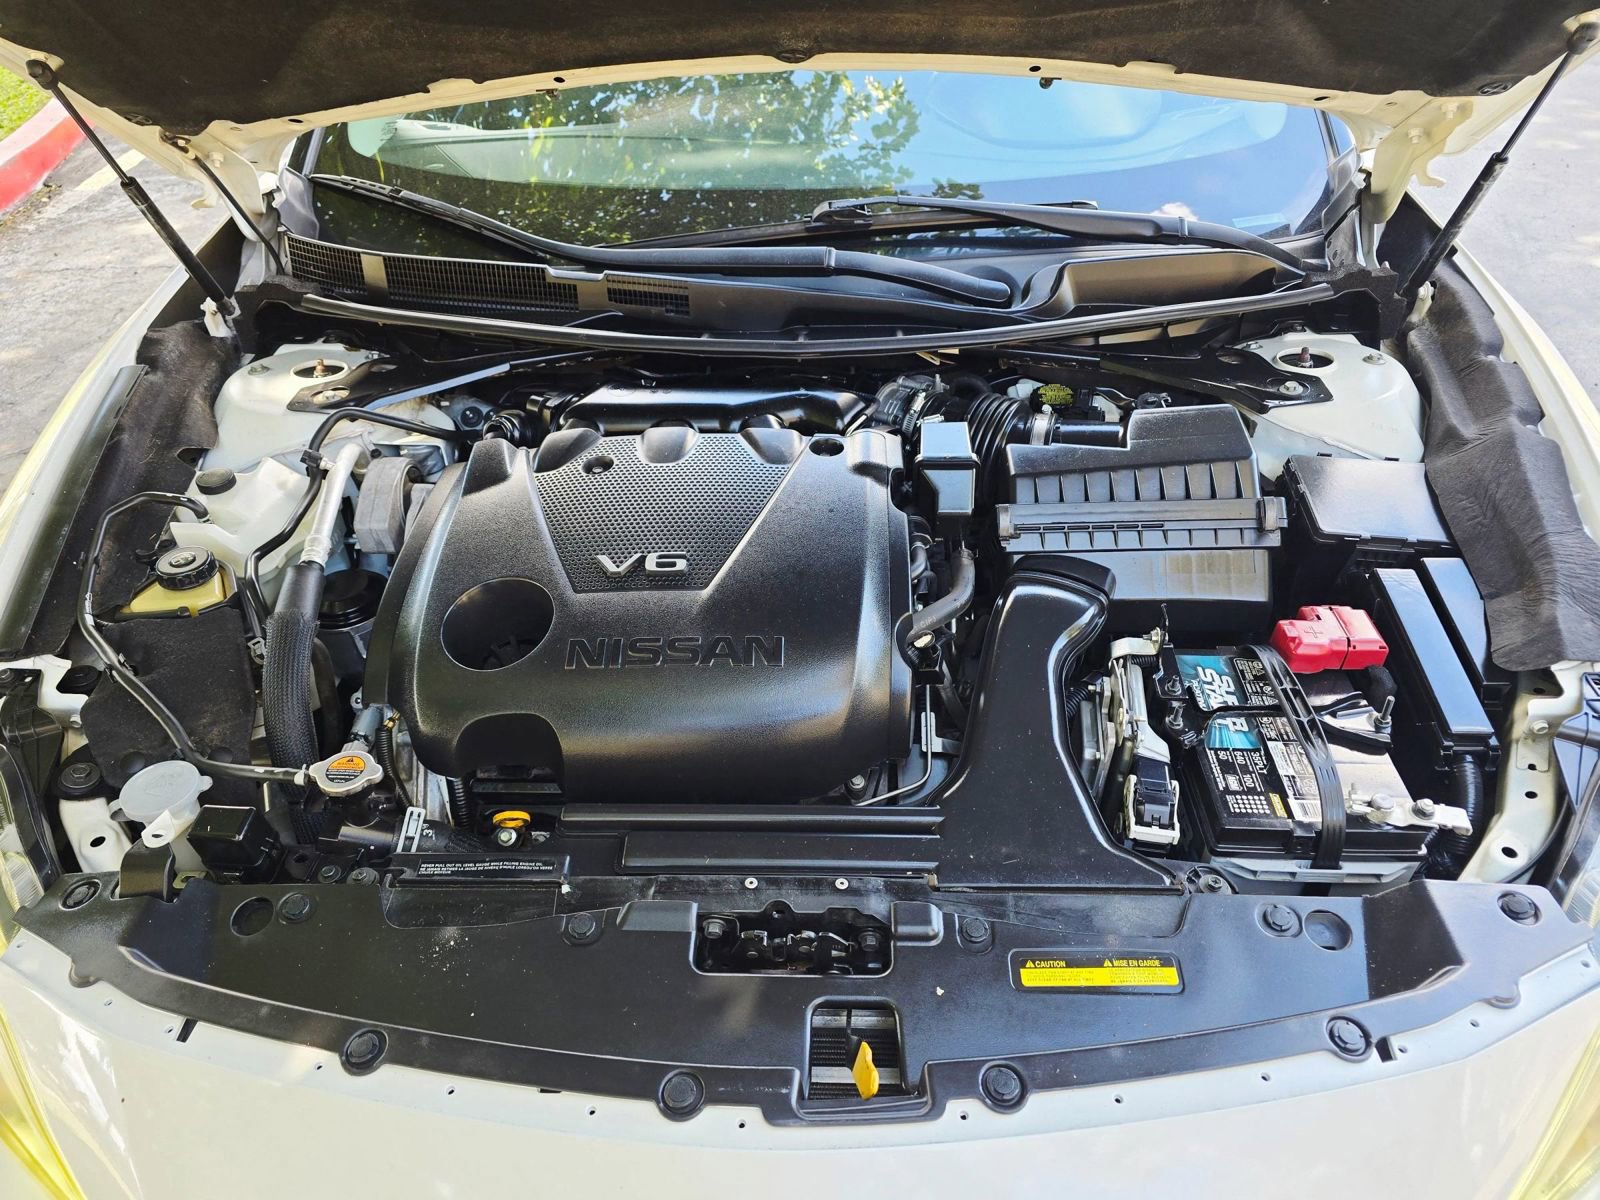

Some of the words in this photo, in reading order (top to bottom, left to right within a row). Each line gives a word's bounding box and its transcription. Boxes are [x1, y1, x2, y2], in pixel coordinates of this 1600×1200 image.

[595, 551, 688, 578] V6
[564, 635, 785, 670] NISSAN
[1217, 750, 1227, 760] 50
[1234, 751, 1246, 765] 640
[1242, 774, 1254, 787] 100
[1035, 960, 1066, 968] CAUTION
[1113, 959, 1129, 967] MISE
[1129, 959, 1138, 967] EN
[1138, 959, 1161, 967] GARDE
